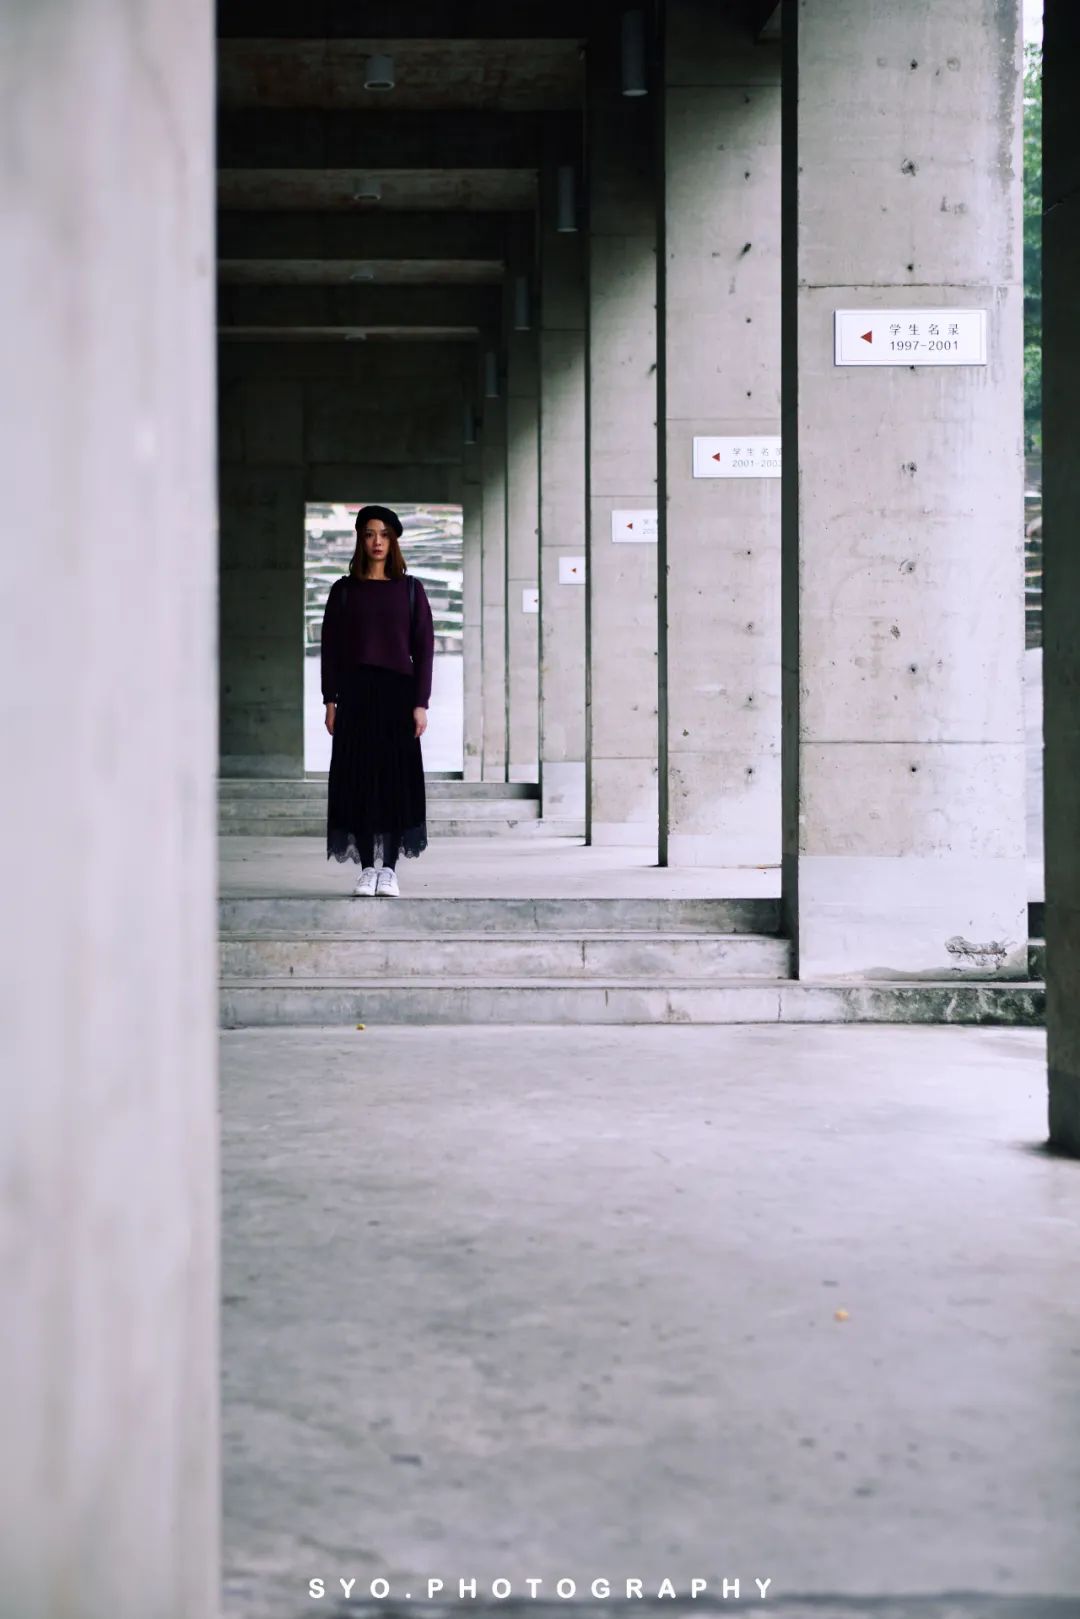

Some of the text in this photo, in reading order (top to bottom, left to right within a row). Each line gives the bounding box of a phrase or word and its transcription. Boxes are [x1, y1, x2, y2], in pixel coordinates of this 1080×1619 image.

[889, 323, 960, 336] 学生名录
[890, 340, 959, 351] 1997-2001
